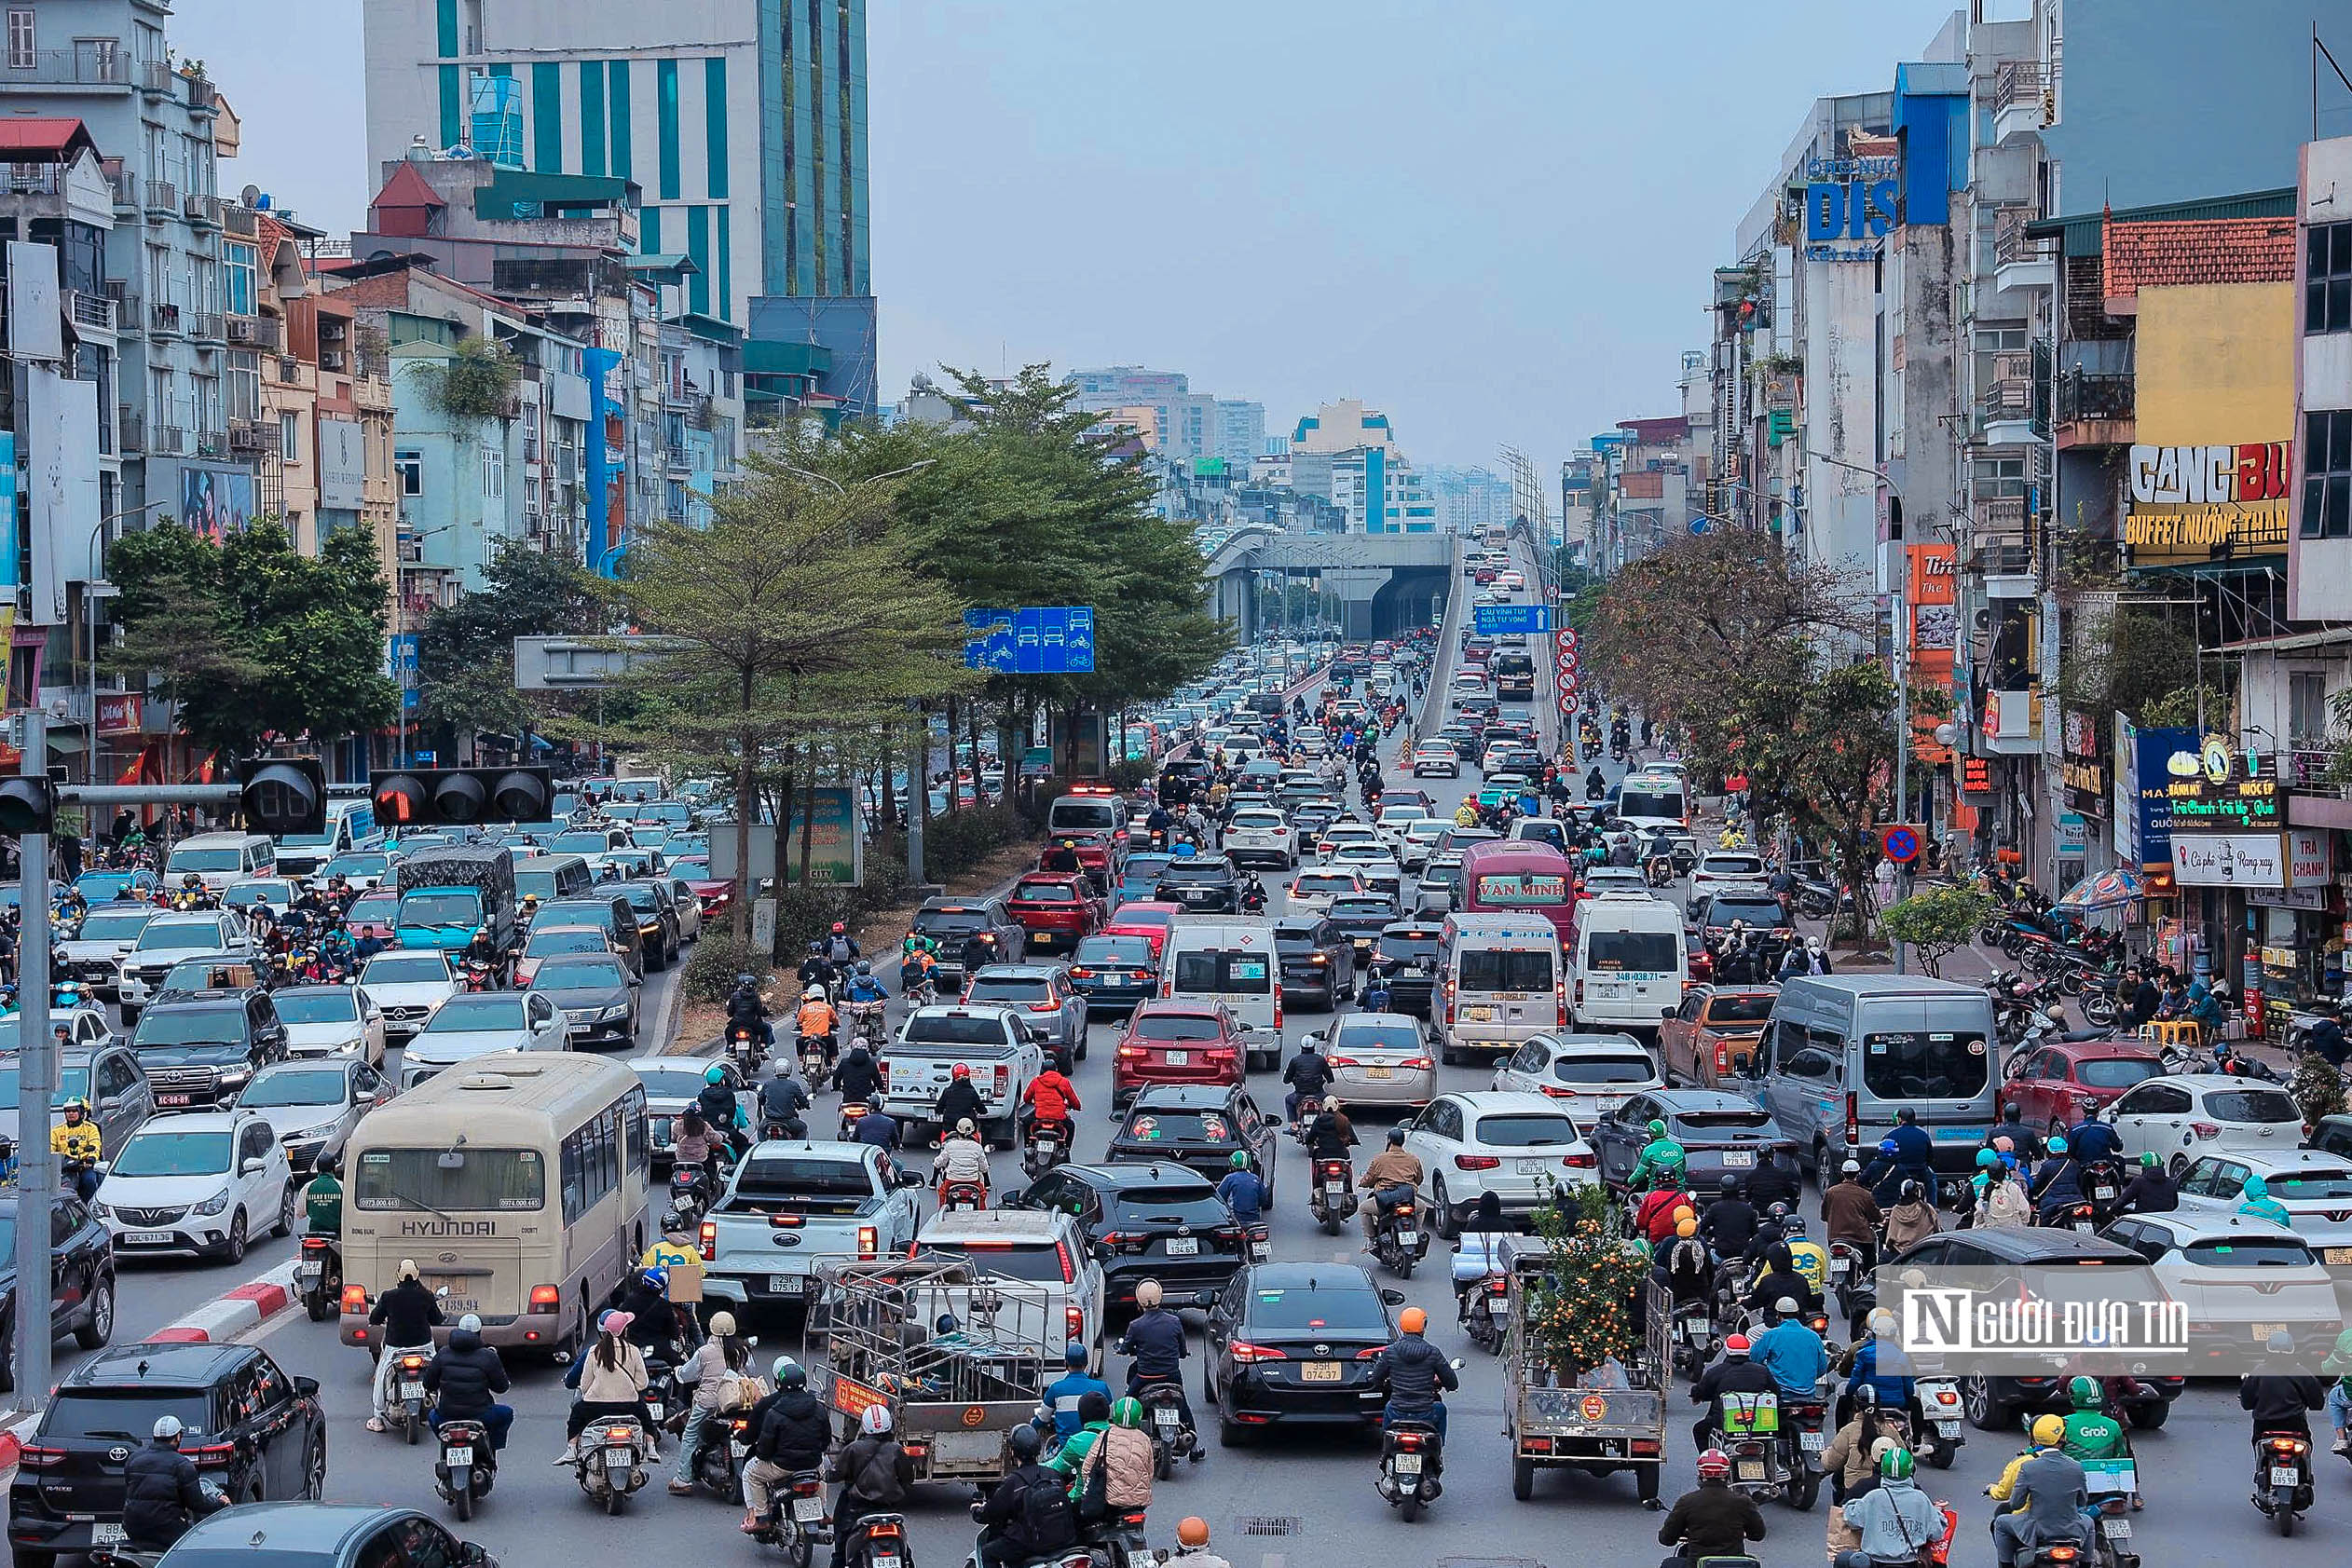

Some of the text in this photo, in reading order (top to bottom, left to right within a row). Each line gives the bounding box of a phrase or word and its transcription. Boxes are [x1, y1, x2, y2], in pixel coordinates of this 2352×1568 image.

[2126, 515, 2181, 545] BUFFET
[2299, 837, 2318, 855] TRÀ
[2191, 851, 2217, 874] Cà phê
[2236, 850, 2274, 876] Rang xay
[2293, 862, 2324, 878] CHANH
[1479, 880, 1566, 896] VĂN MINH
[402, 1220, 496, 1236] HYUNDAI
[773, 1283, 800, 1292] 075.12
[1306, 1370, 1336, 1380] 074.37
[2080, 1425, 2109, 1437] Grab
